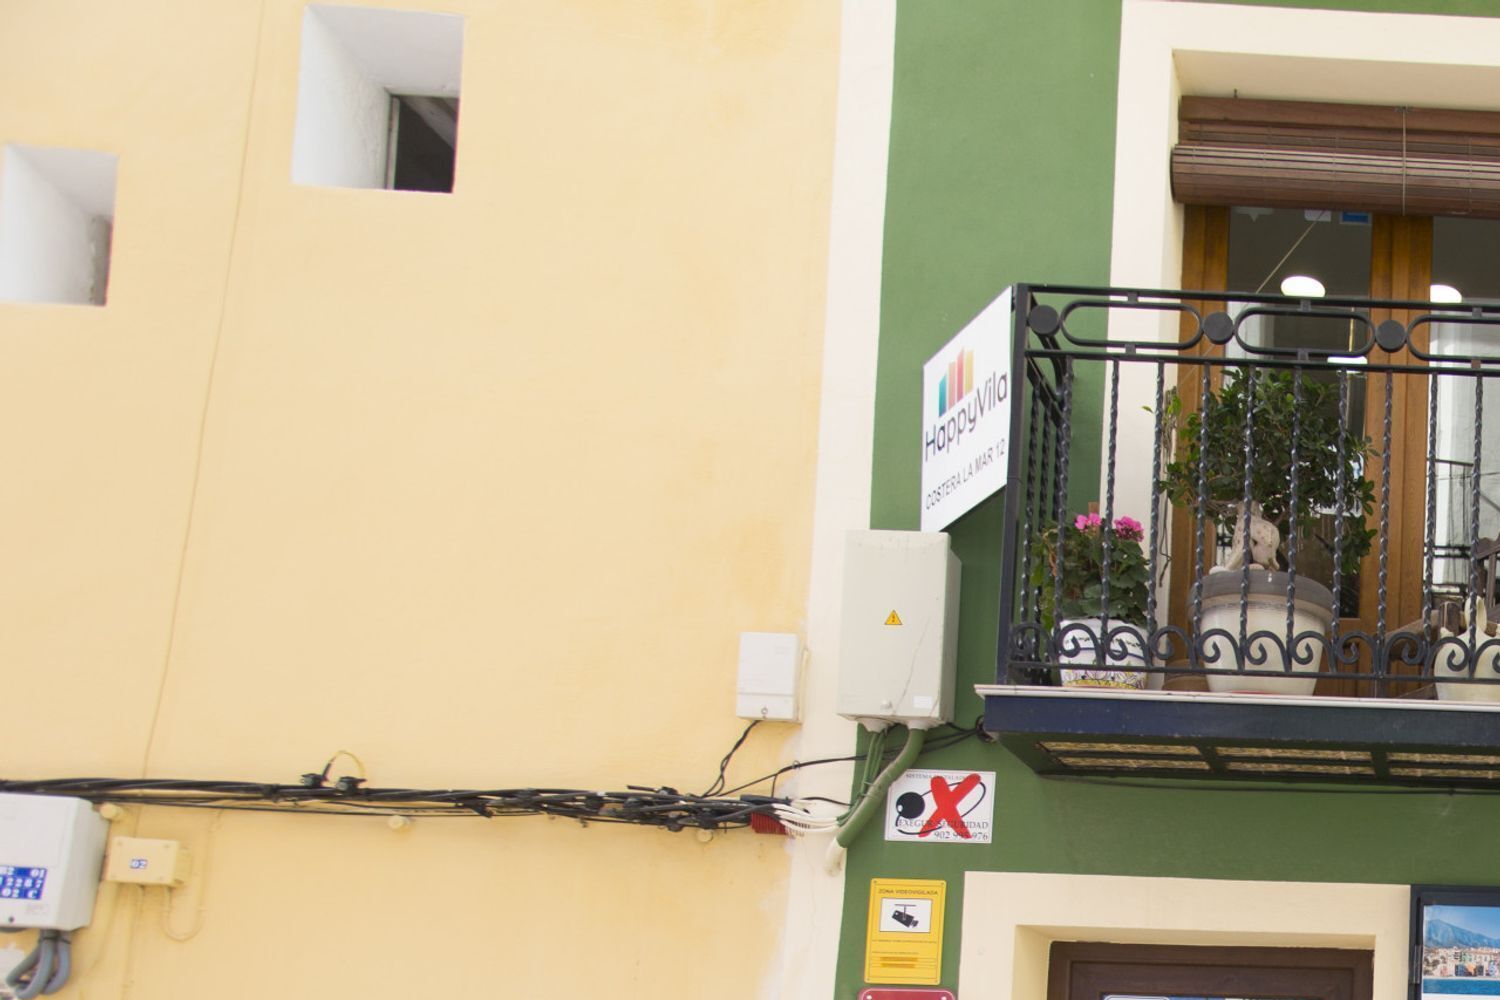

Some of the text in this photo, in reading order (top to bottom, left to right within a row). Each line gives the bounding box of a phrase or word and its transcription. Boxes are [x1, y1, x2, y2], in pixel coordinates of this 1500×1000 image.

[925, 371, 1008, 462] HappyVila
[926, 438, 1006, 510] COSTERA LA MAR 12
